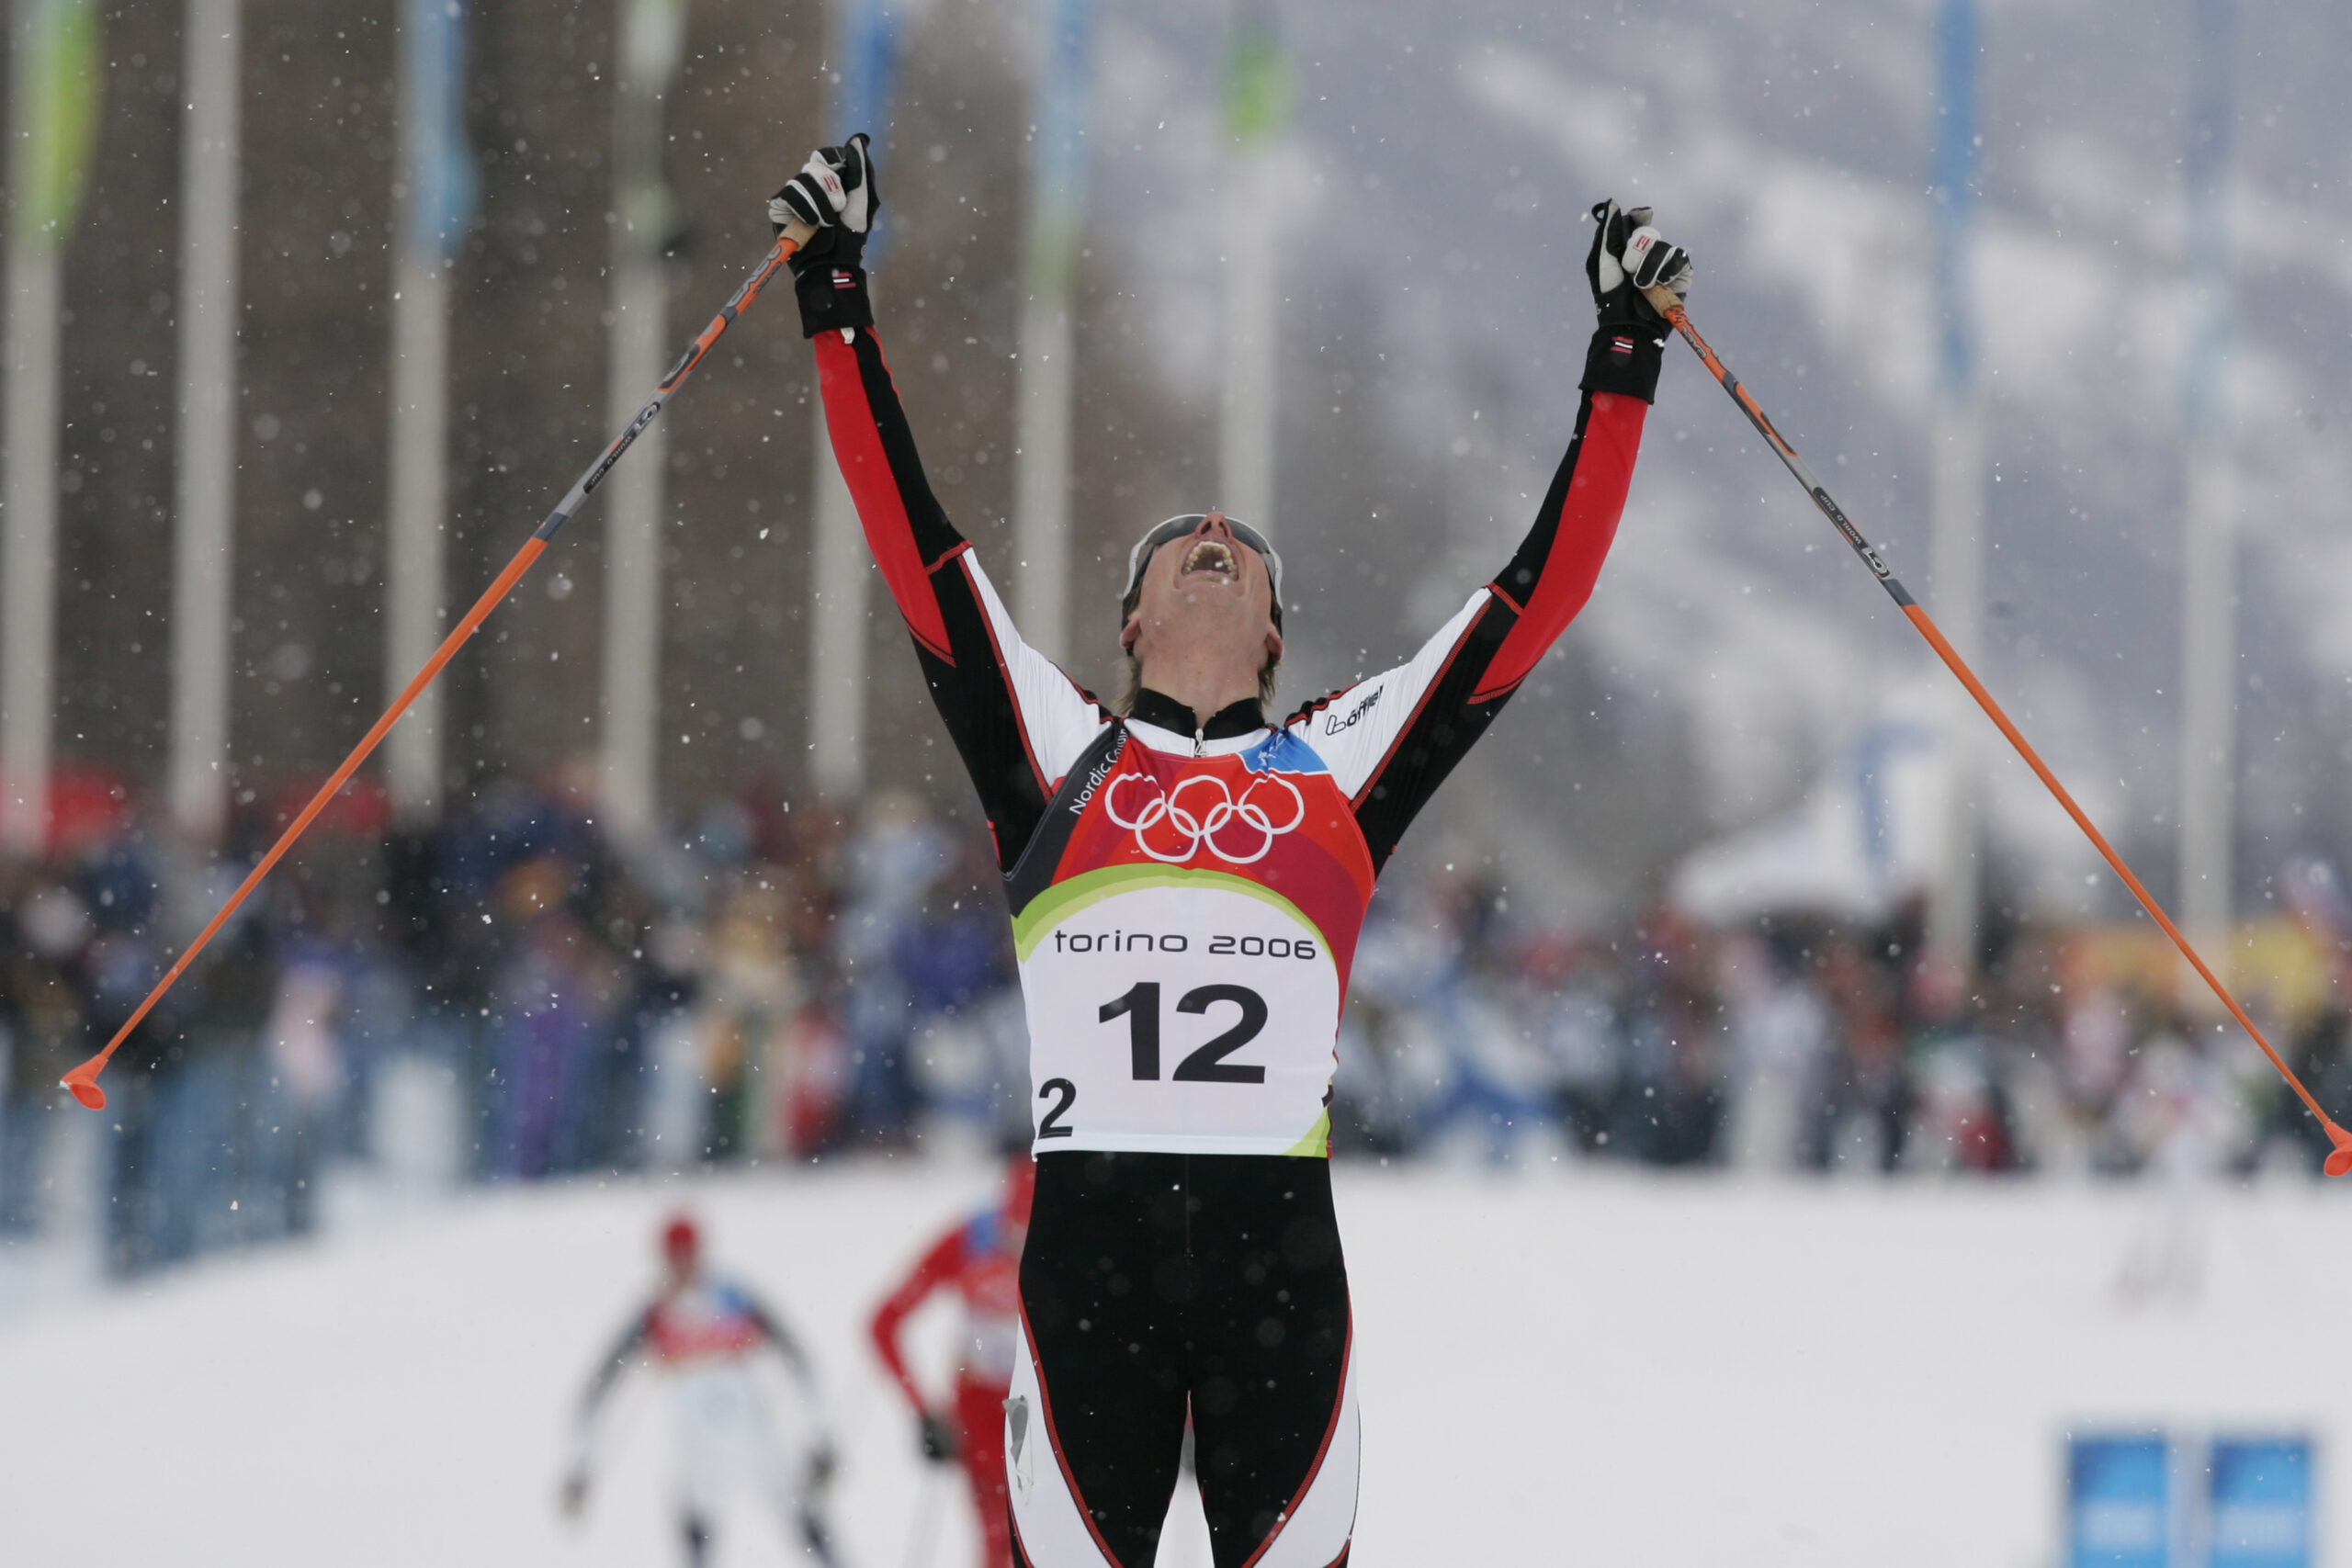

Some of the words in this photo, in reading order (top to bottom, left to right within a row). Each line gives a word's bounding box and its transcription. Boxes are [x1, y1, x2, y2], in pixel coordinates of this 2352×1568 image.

[607, 435, 632, 465] WORLD
[590, 468, 605, 485] CUP
[1820, 495, 1836, 511] CUP
[1837, 514, 1862, 545] WORLD
[1069, 762, 1113, 816] Nordic
[1055, 930, 1188, 953] torino
[1208, 935, 1317, 960] 2006
[1098, 981, 1269, 1084] 12
[1038, 1077, 1077, 1140] 2
